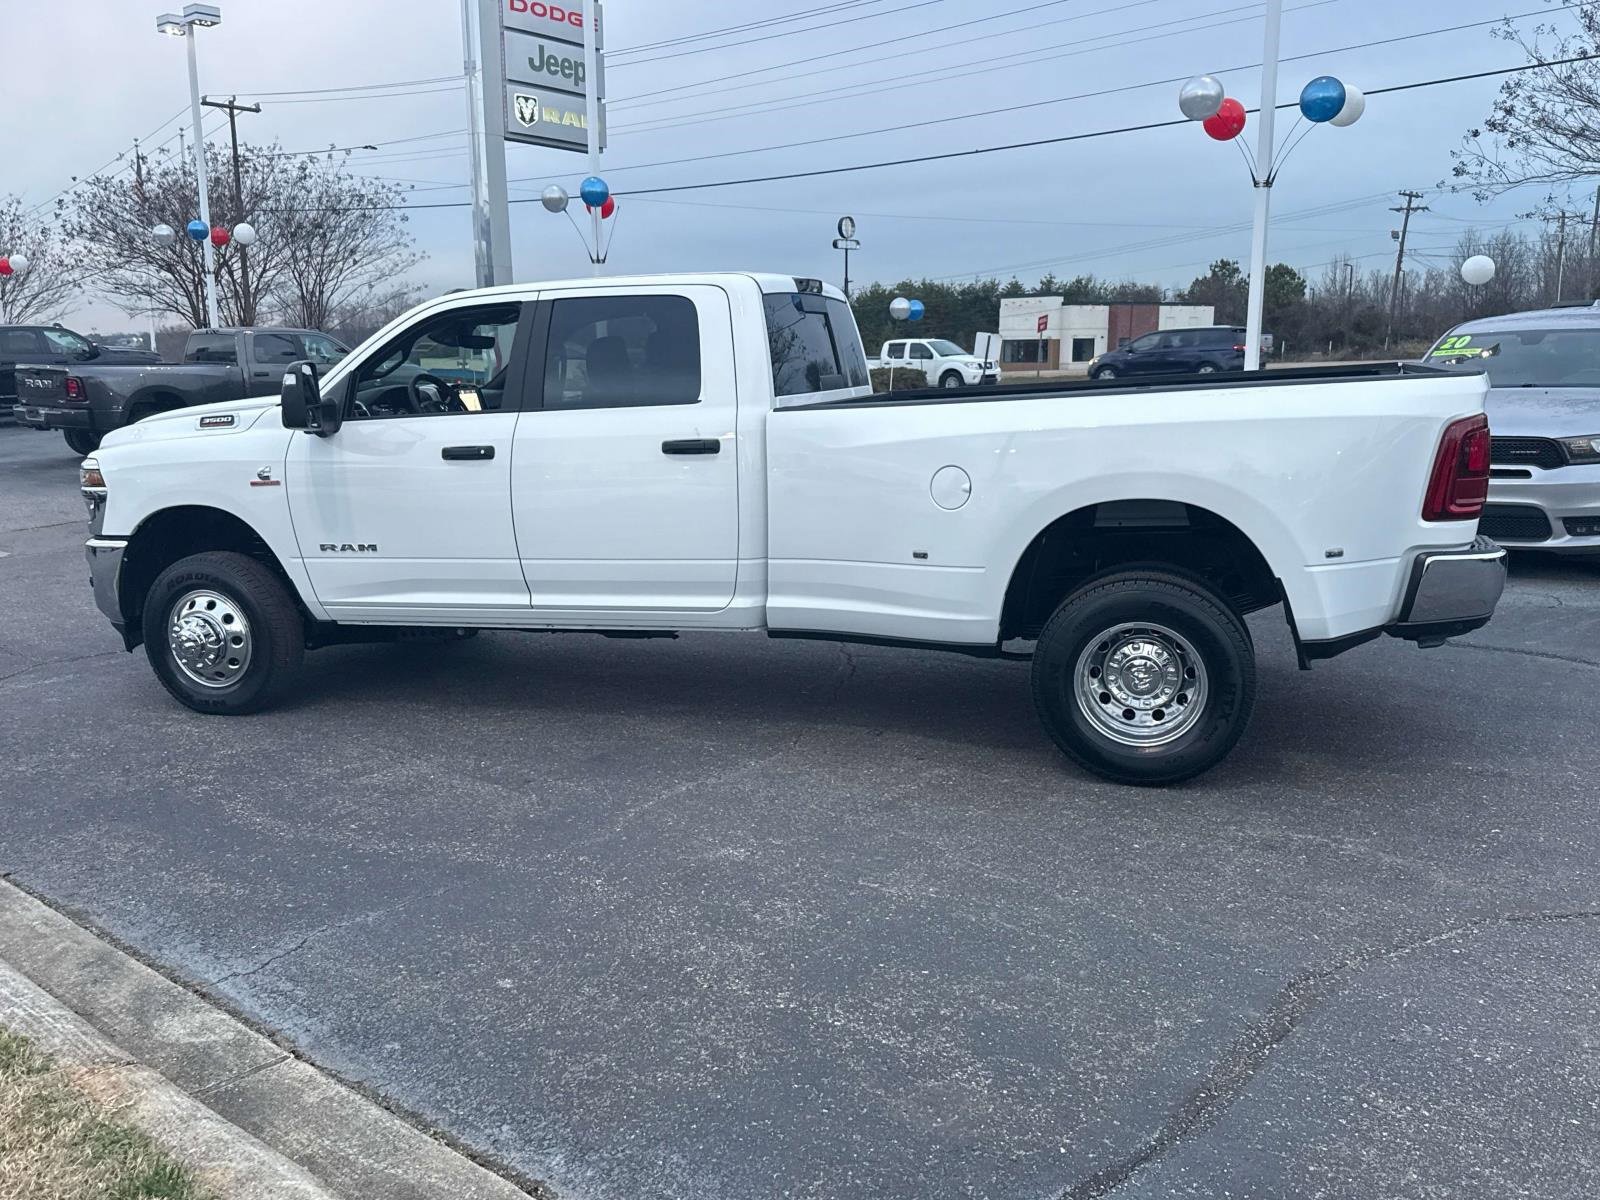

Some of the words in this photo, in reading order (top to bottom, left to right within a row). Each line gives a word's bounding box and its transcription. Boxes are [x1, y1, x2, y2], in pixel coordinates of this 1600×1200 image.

[510, 0, 599, 32] DODG
[528, 44, 586, 87] Jeep
[1440, 335, 1472, 349] 20
[24, 378, 53, 389] RAM
[202, 416, 232, 424] 3500
[319, 543, 378, 552] RAM
